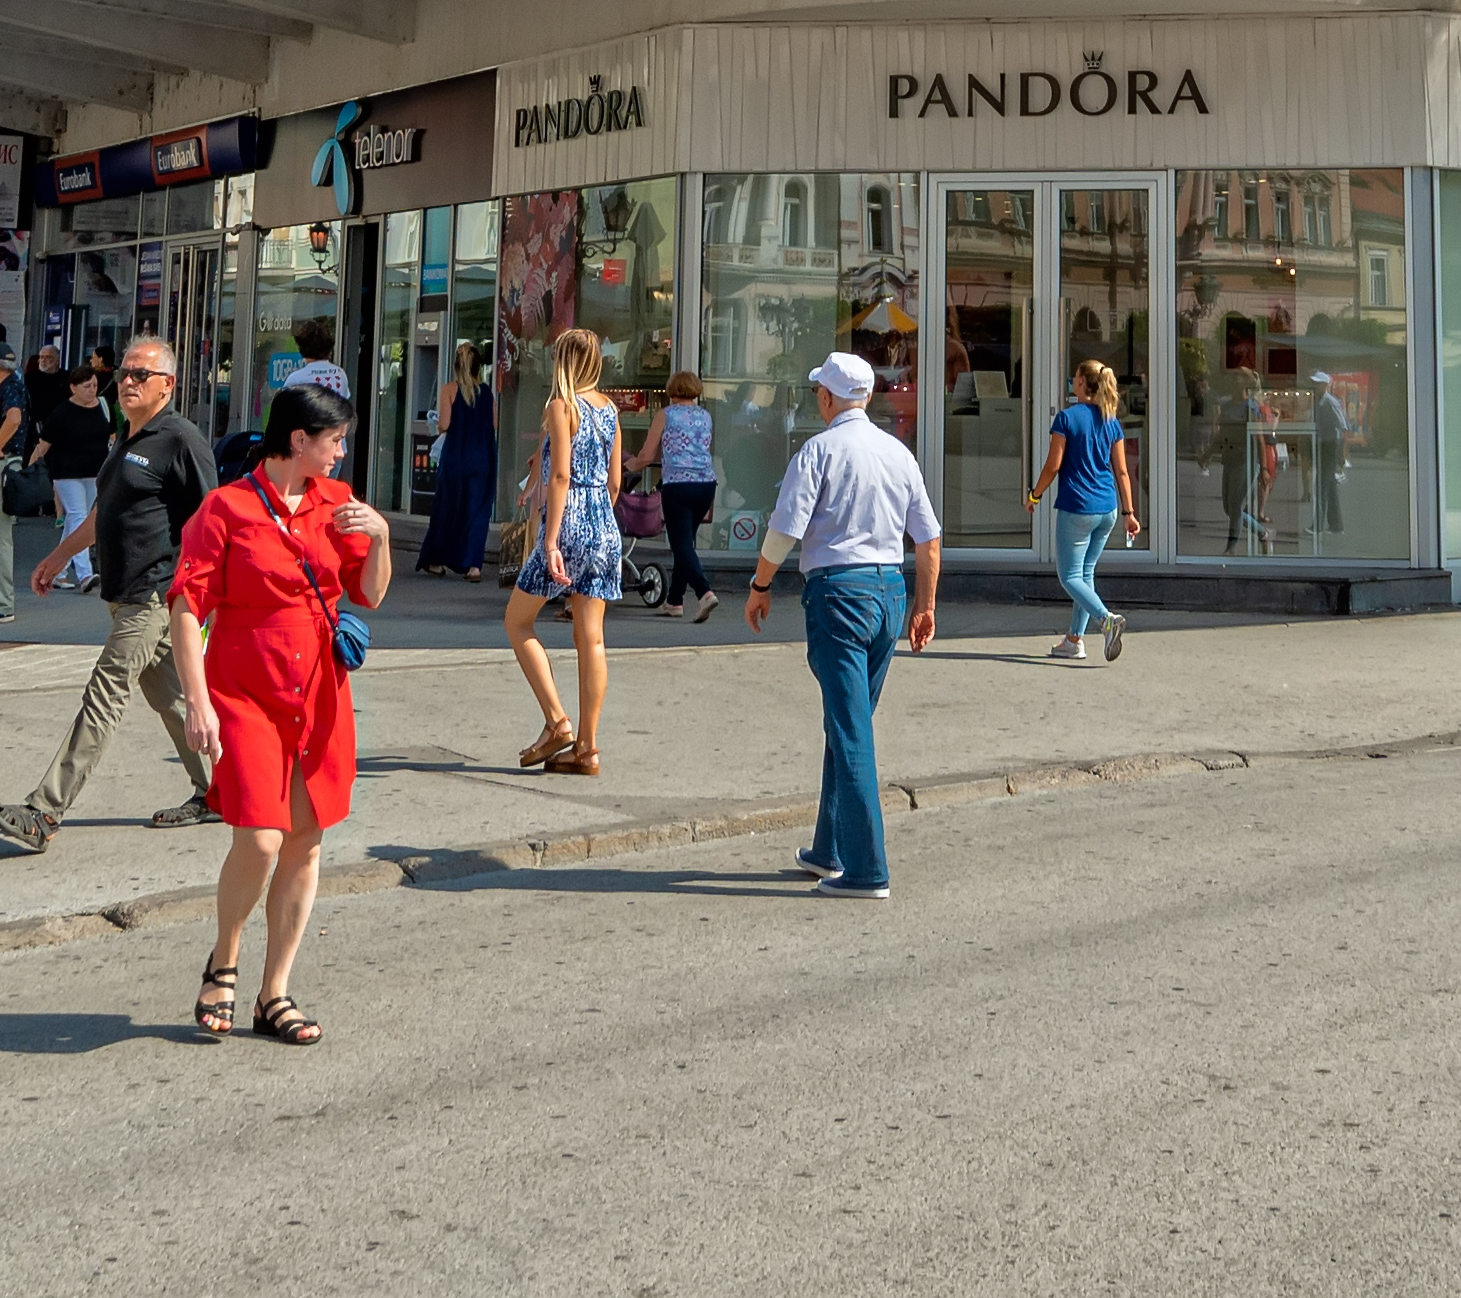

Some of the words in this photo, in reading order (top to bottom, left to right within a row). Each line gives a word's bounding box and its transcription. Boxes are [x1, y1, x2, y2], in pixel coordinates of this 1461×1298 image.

[514, 84, 646, 149] PANDORA
[887, 67, 1211, 120] PANDORA
[157, 142, 197, 172] Eurobank
[354, 124, 416, 170] telenor
[59, 166, 92, 191] Eurobank
